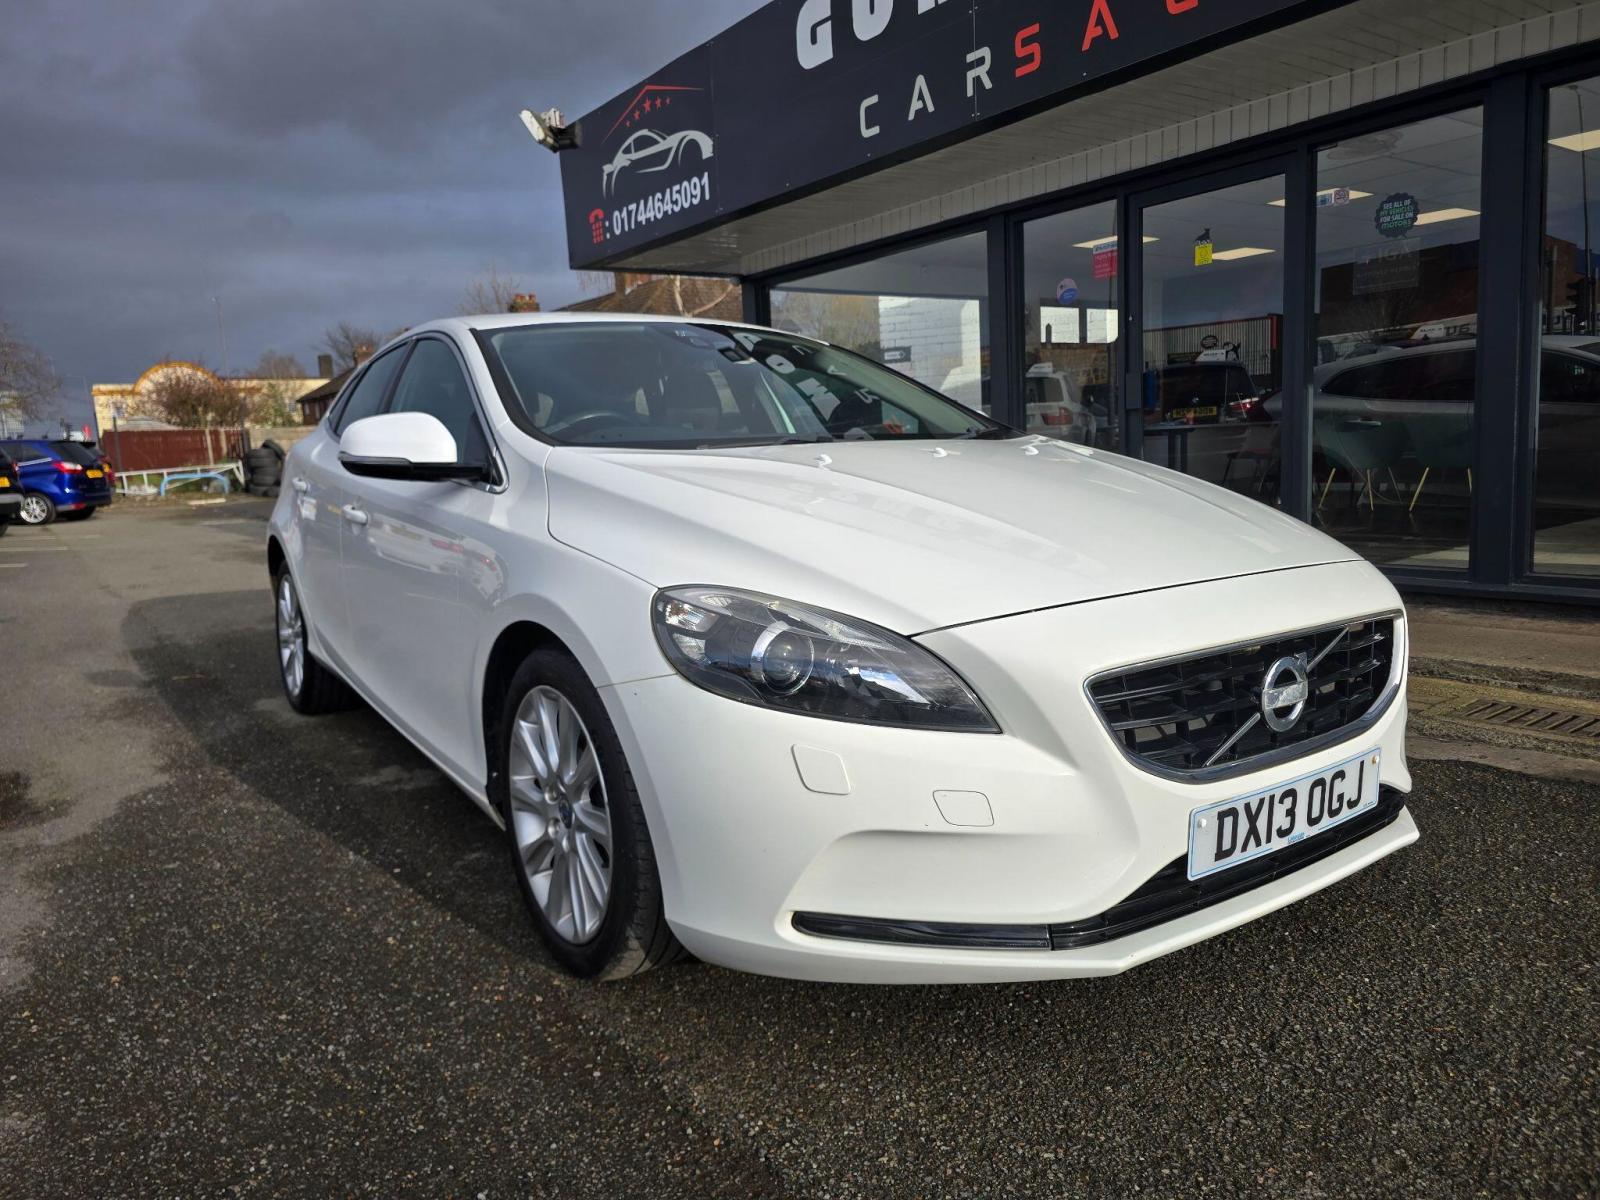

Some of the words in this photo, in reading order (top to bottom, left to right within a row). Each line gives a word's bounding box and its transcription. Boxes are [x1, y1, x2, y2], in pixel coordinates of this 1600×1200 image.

[613, 171, 710, 235] 01744645091
[1214, 788, 1298, 862] DX13
[1306, 760, 1365, 827] OGJ
